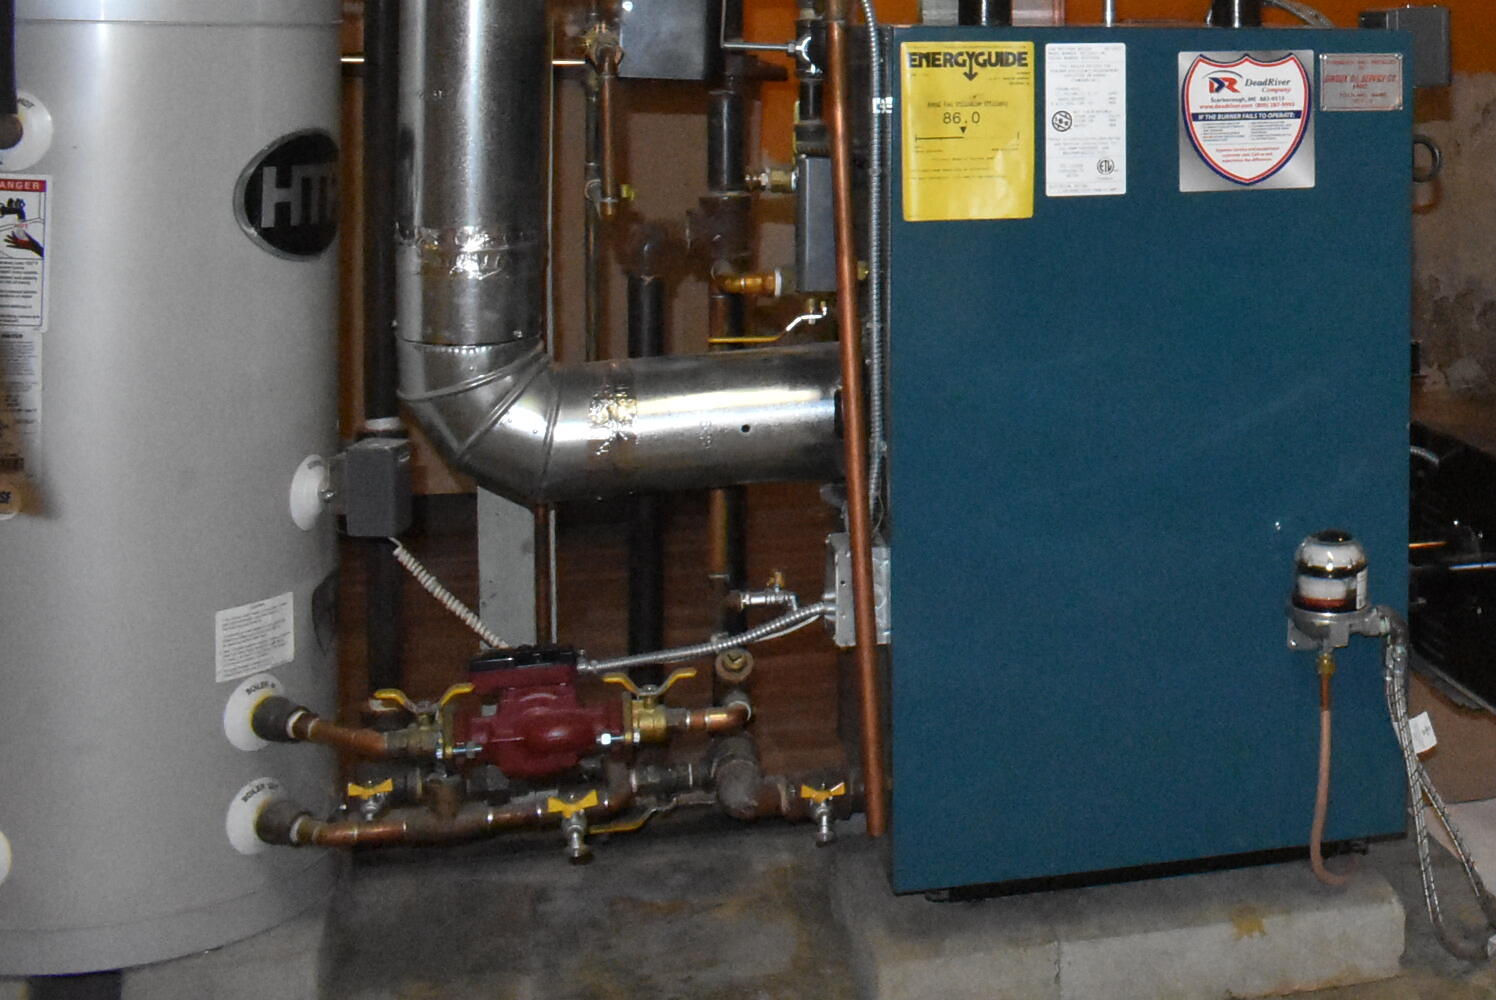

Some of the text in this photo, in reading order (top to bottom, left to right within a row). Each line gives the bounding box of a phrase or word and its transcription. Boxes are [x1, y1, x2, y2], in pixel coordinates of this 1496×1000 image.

[908, 51, 1029, 69] ENERGYGUIDE
[943, 111, 981, 124] 86.0
[0, 181, 40, 190] ANGER
